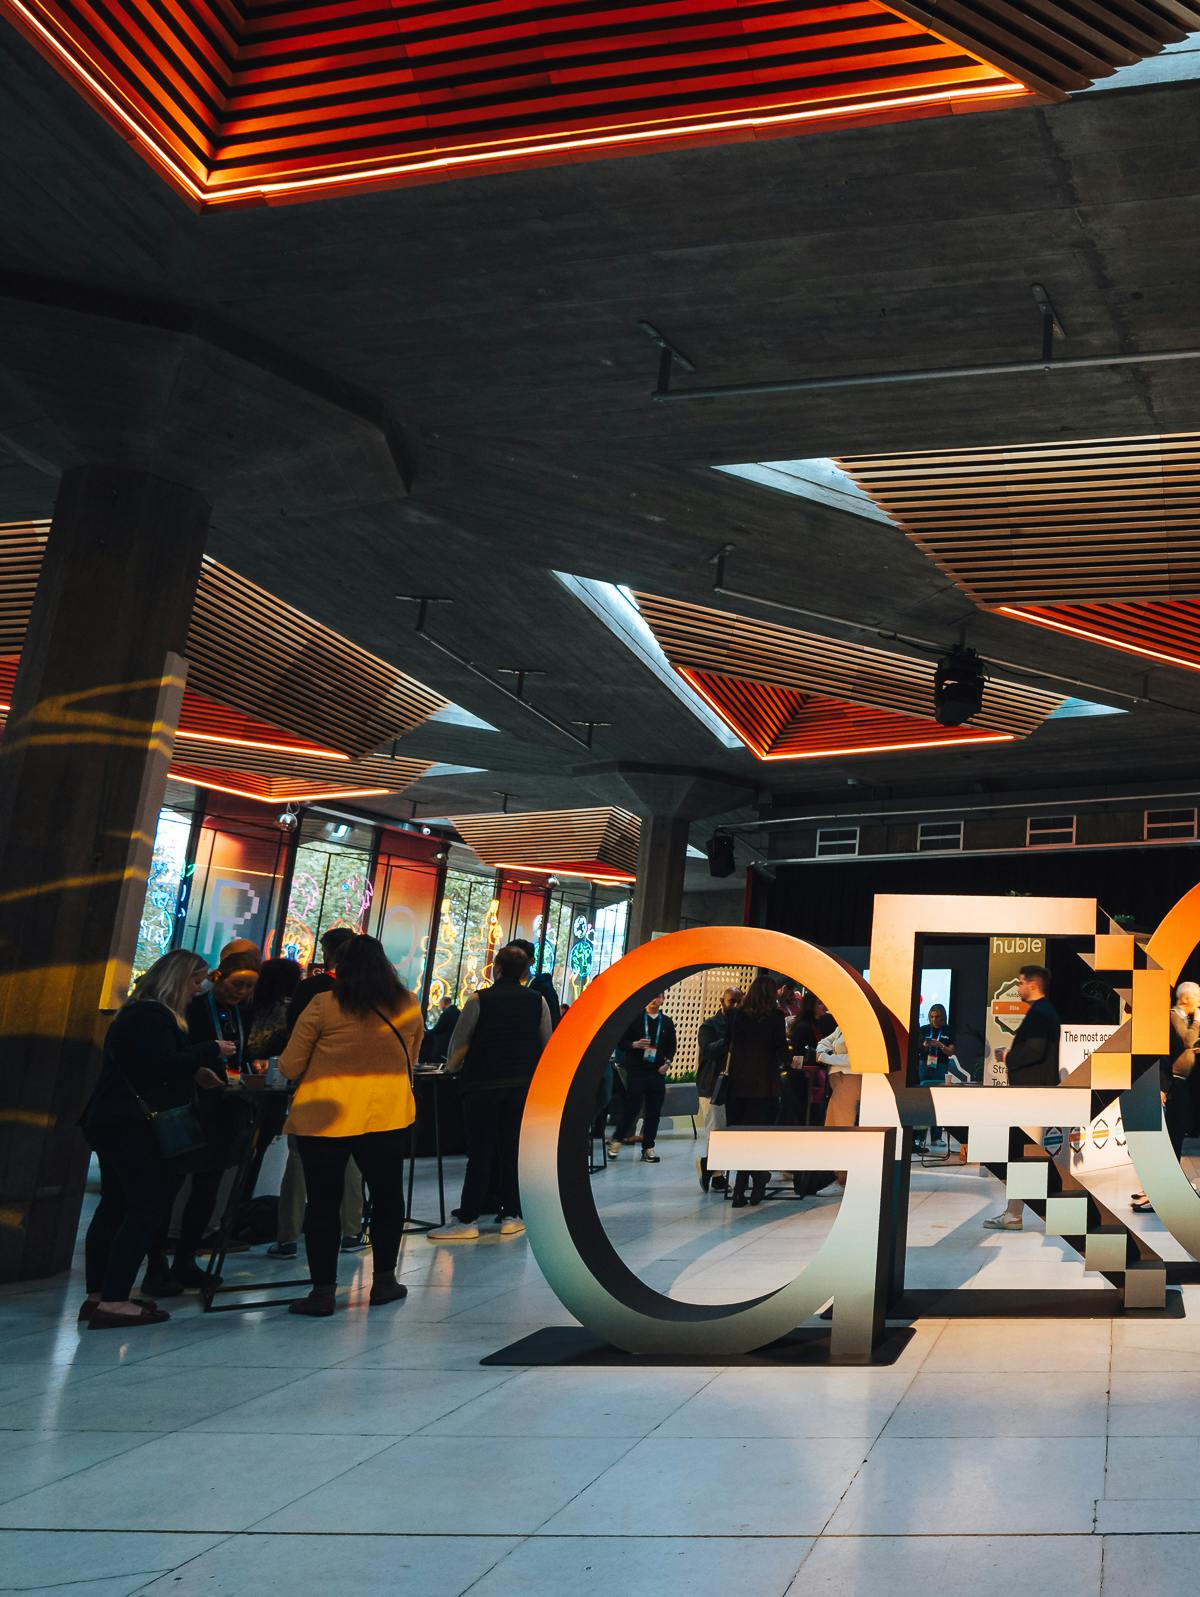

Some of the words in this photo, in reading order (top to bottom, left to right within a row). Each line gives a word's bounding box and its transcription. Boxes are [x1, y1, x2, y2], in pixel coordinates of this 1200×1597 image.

[992, 937, 1042, 954] huble
[1064, 1031, 1079, 1042] The
[1079, 1031, 1099, 1042] most
